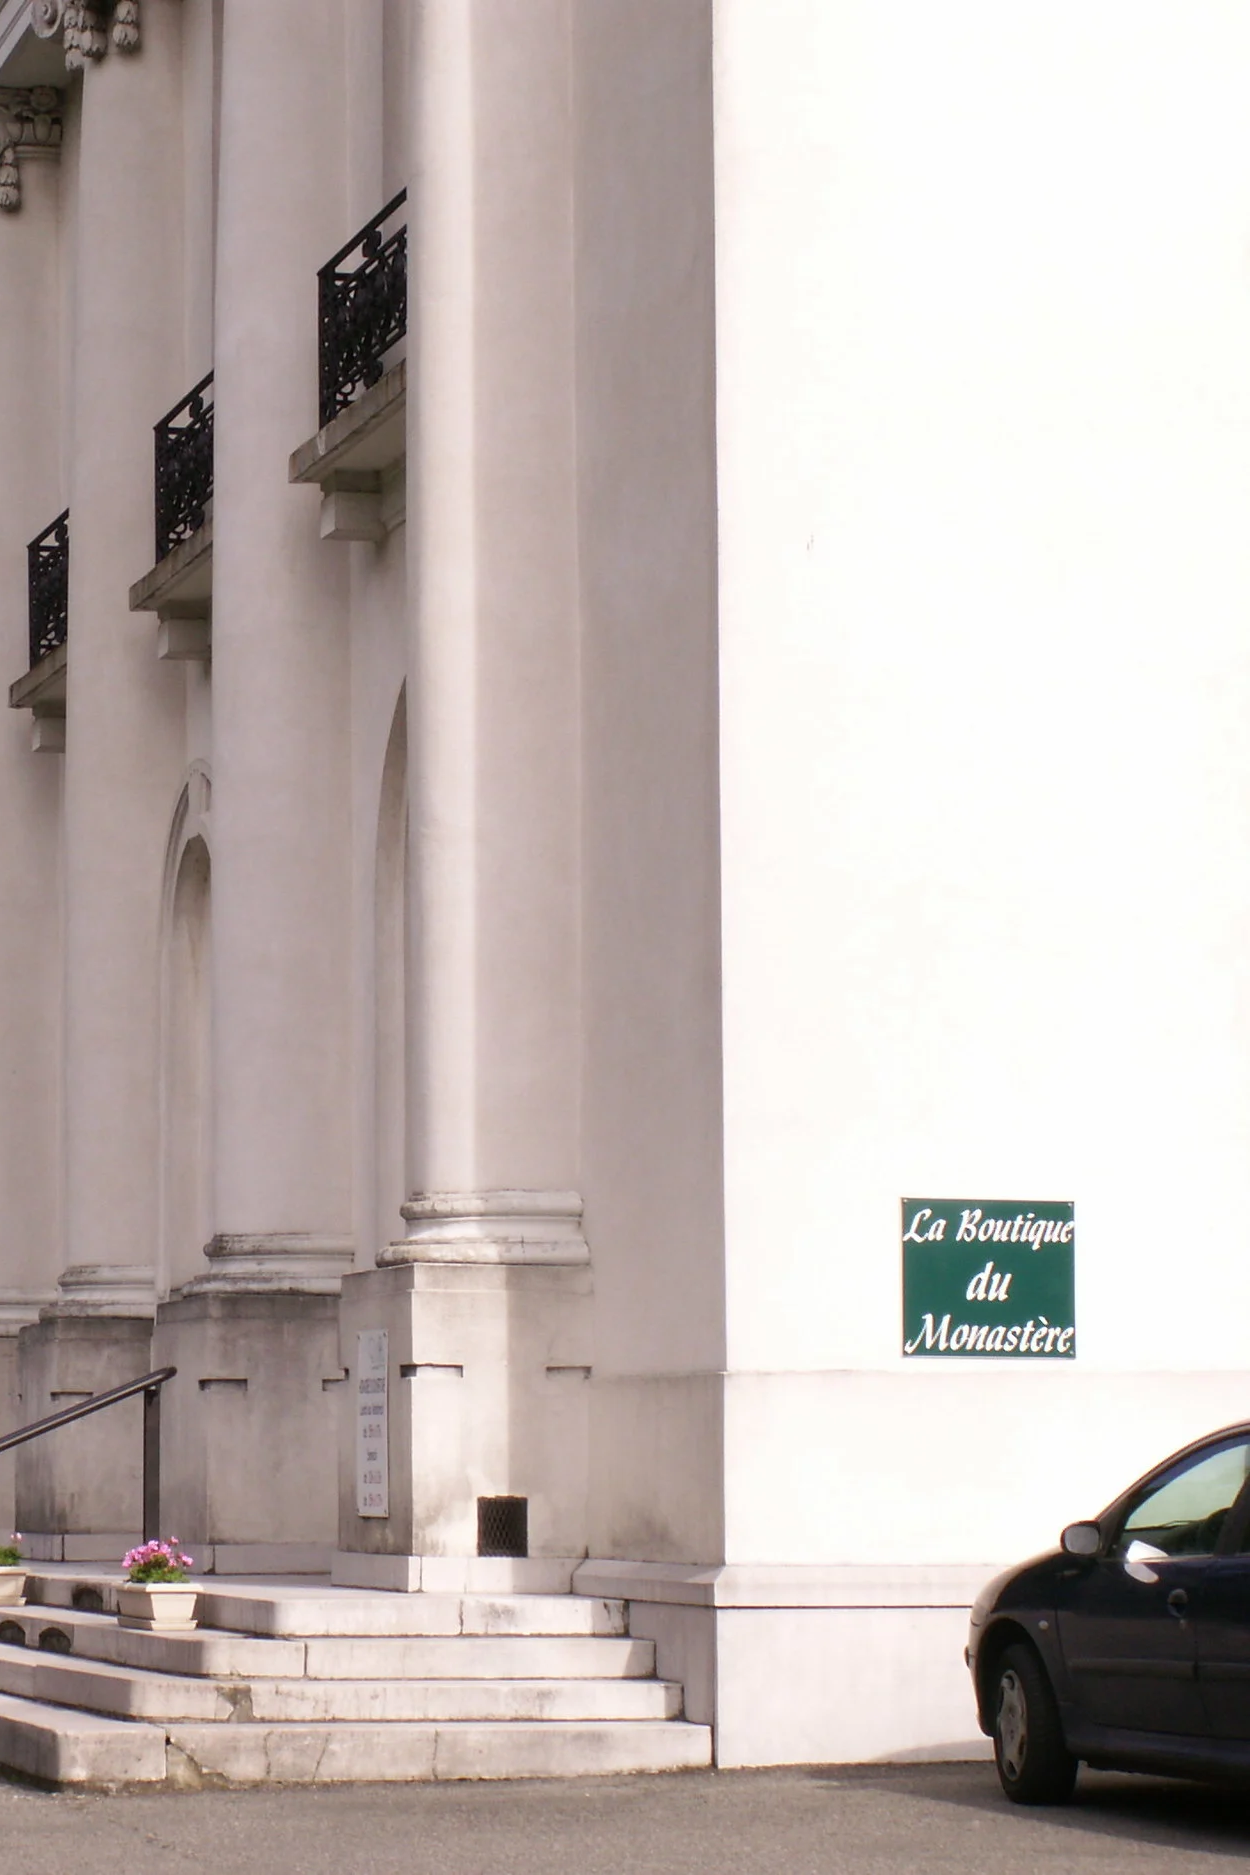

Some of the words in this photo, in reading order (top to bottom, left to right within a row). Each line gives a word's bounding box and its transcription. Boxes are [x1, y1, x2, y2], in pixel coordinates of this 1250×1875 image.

[903, 1208, 946, 1242] La
[956, 1208, 1074, 1250] Boutique
[965, 1261, 1012, 1301] du
[904, 1313, 1074, 1354] Monastère
